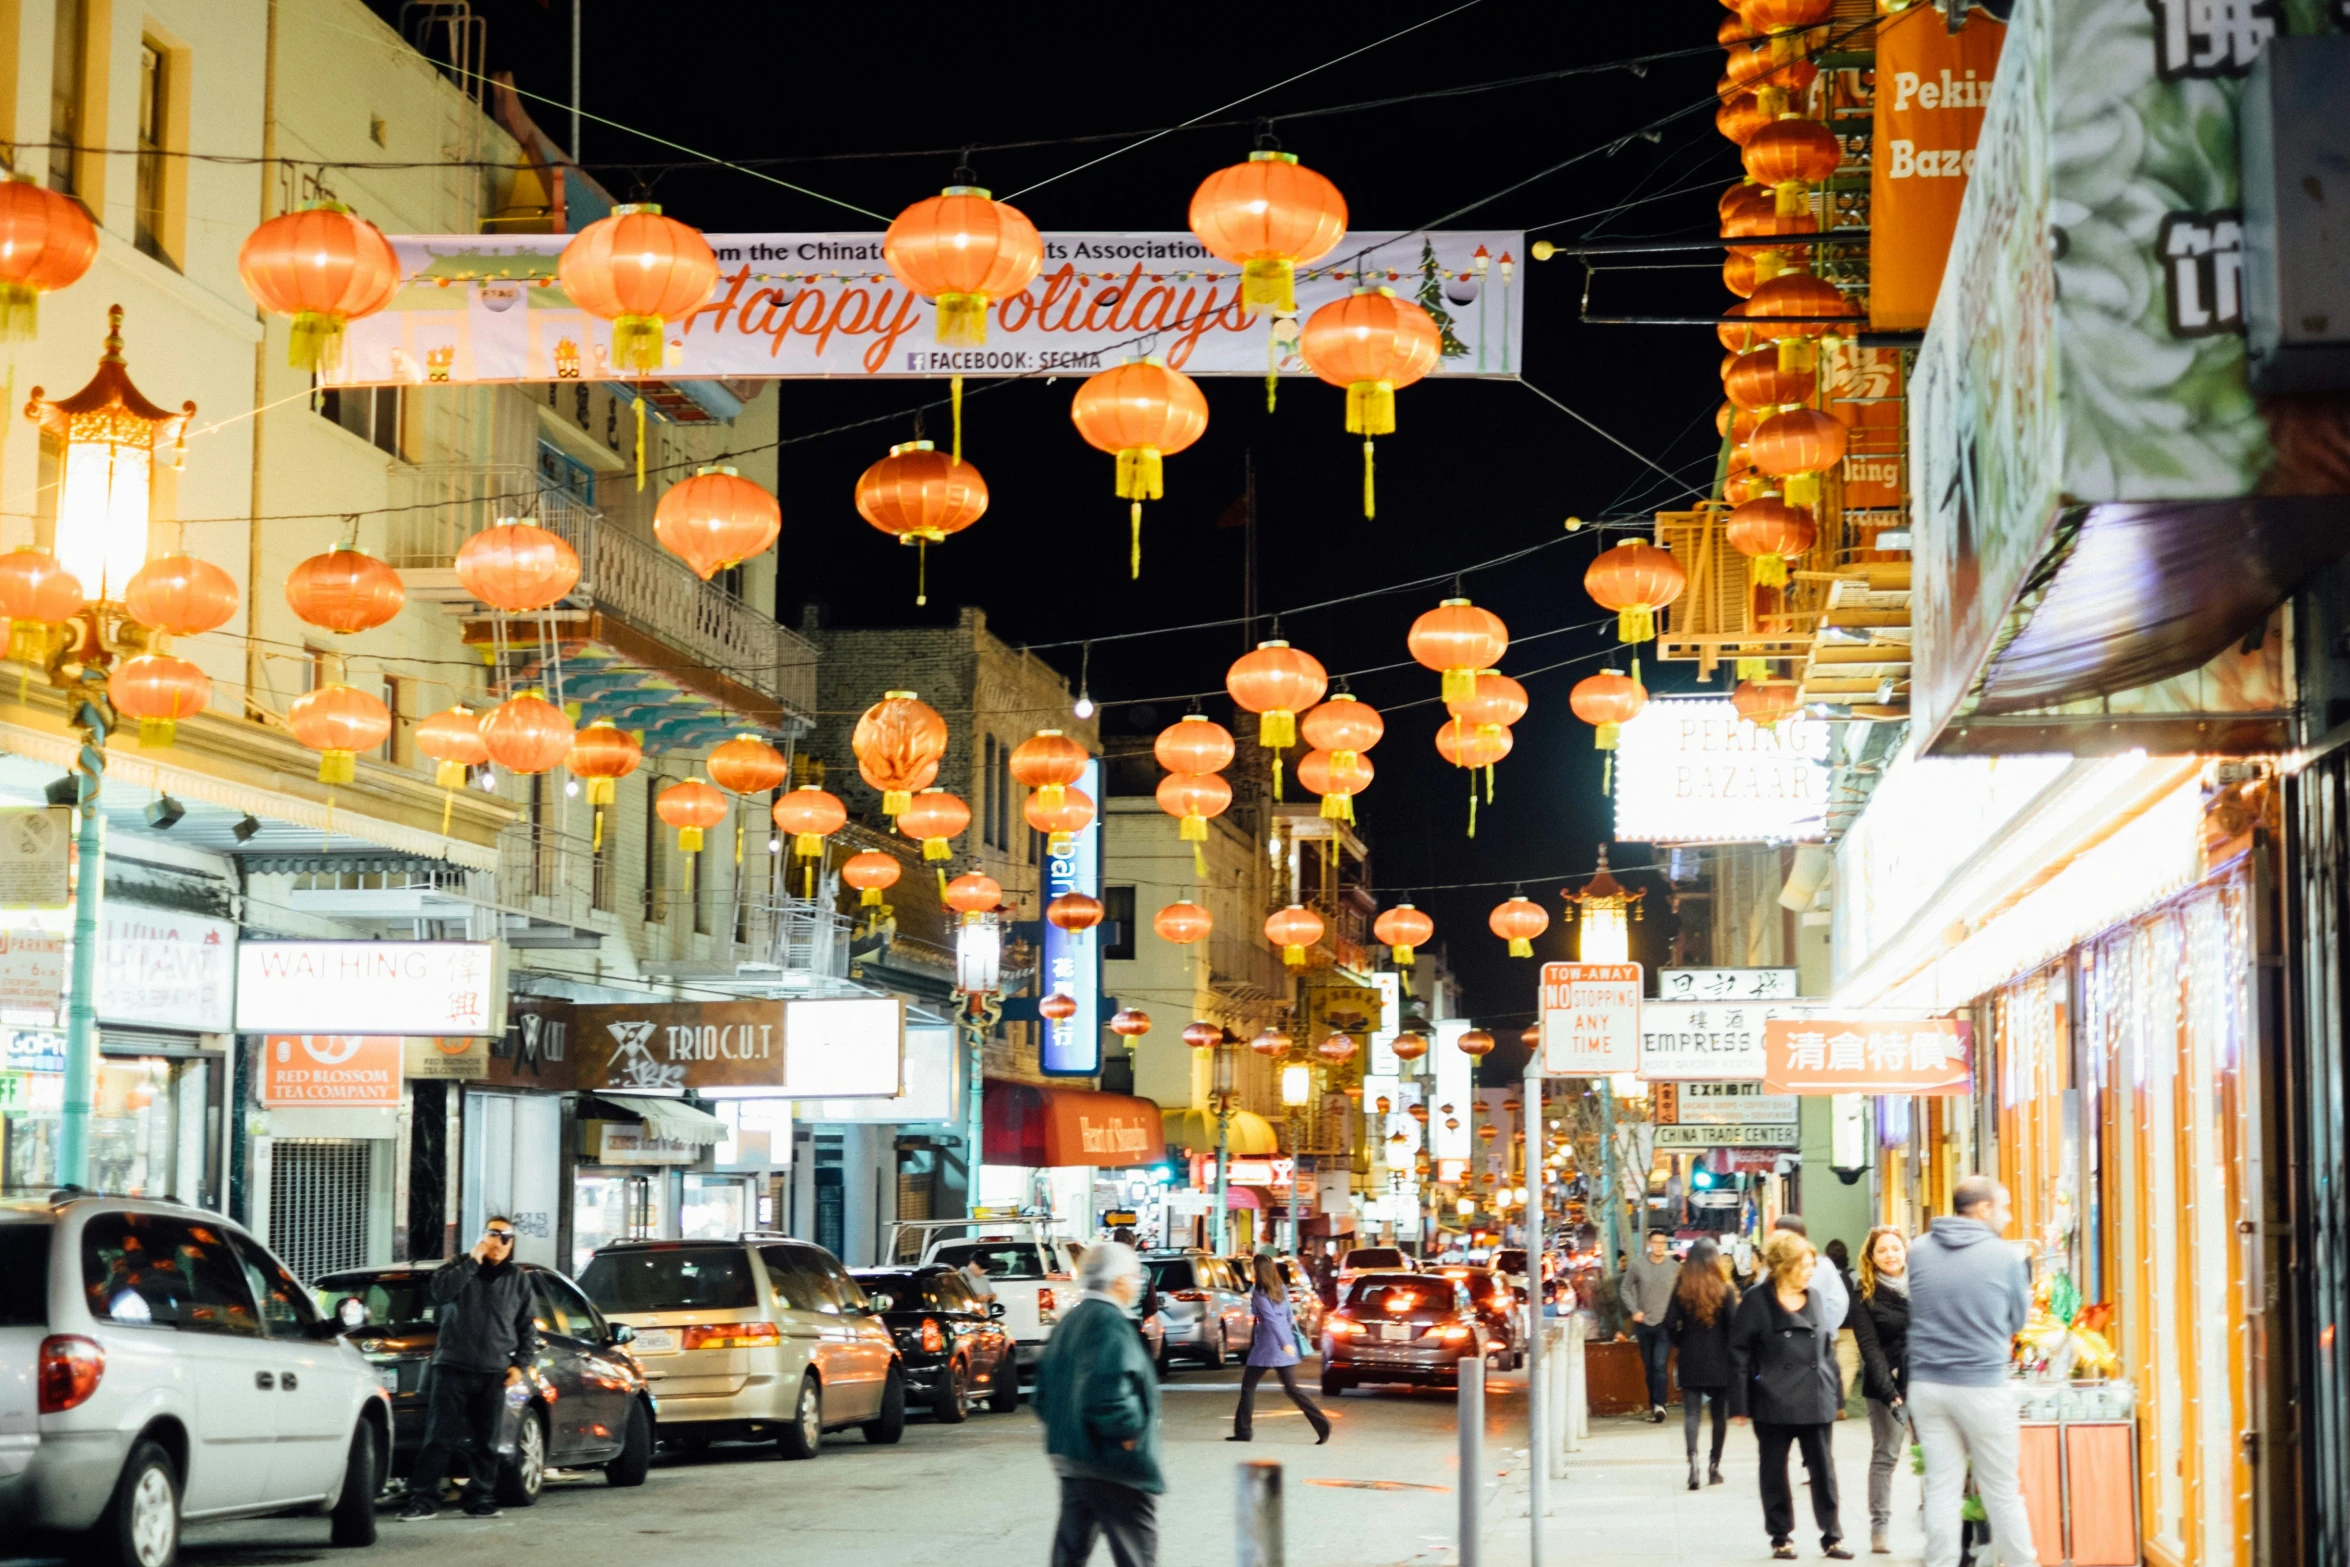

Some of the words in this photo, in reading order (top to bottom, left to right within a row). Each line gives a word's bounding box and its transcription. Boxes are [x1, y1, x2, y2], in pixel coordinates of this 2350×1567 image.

[750, 243, 789, 261] the
[681, 263, 919, 374] Happy
[990, 261, 1259, 371] olidays
[930, 353, 1033, 369] FACEBOOK:
[1675, 766, 1810, 799] BAZAAR
[261, 951, 325, 978] WAI
[340, 951, 427, 979] HING
[1549, 967, 1634, 981] TOW-AWAY
[1546, 984, 1571, 1009] NO
[1573, 989, 1633, 1007] STOPPING
[1574, 1015, 1609, 1032] ANY
[666, 1024, 718, 1062] TRIO
[1572, 1036, 1612, 1054] TIME
[1643, 1032, 1751, 1053] EMPRESS
[1786, 1031, 1947, 1072] 清倉特價
[275, 1070, 310, 1083] RED
[313, 1070, 389, 1083] BLOSSOM
[273, 1085, 303, 1098] TEA
[306, 1085, 388, 1098] COMPANY
[1661, 1129, 1698, 1142] CHINA
[1702, 1129, 1741, 1143] TRADE
[1744, 1128, 1794, 1143] CENTER
